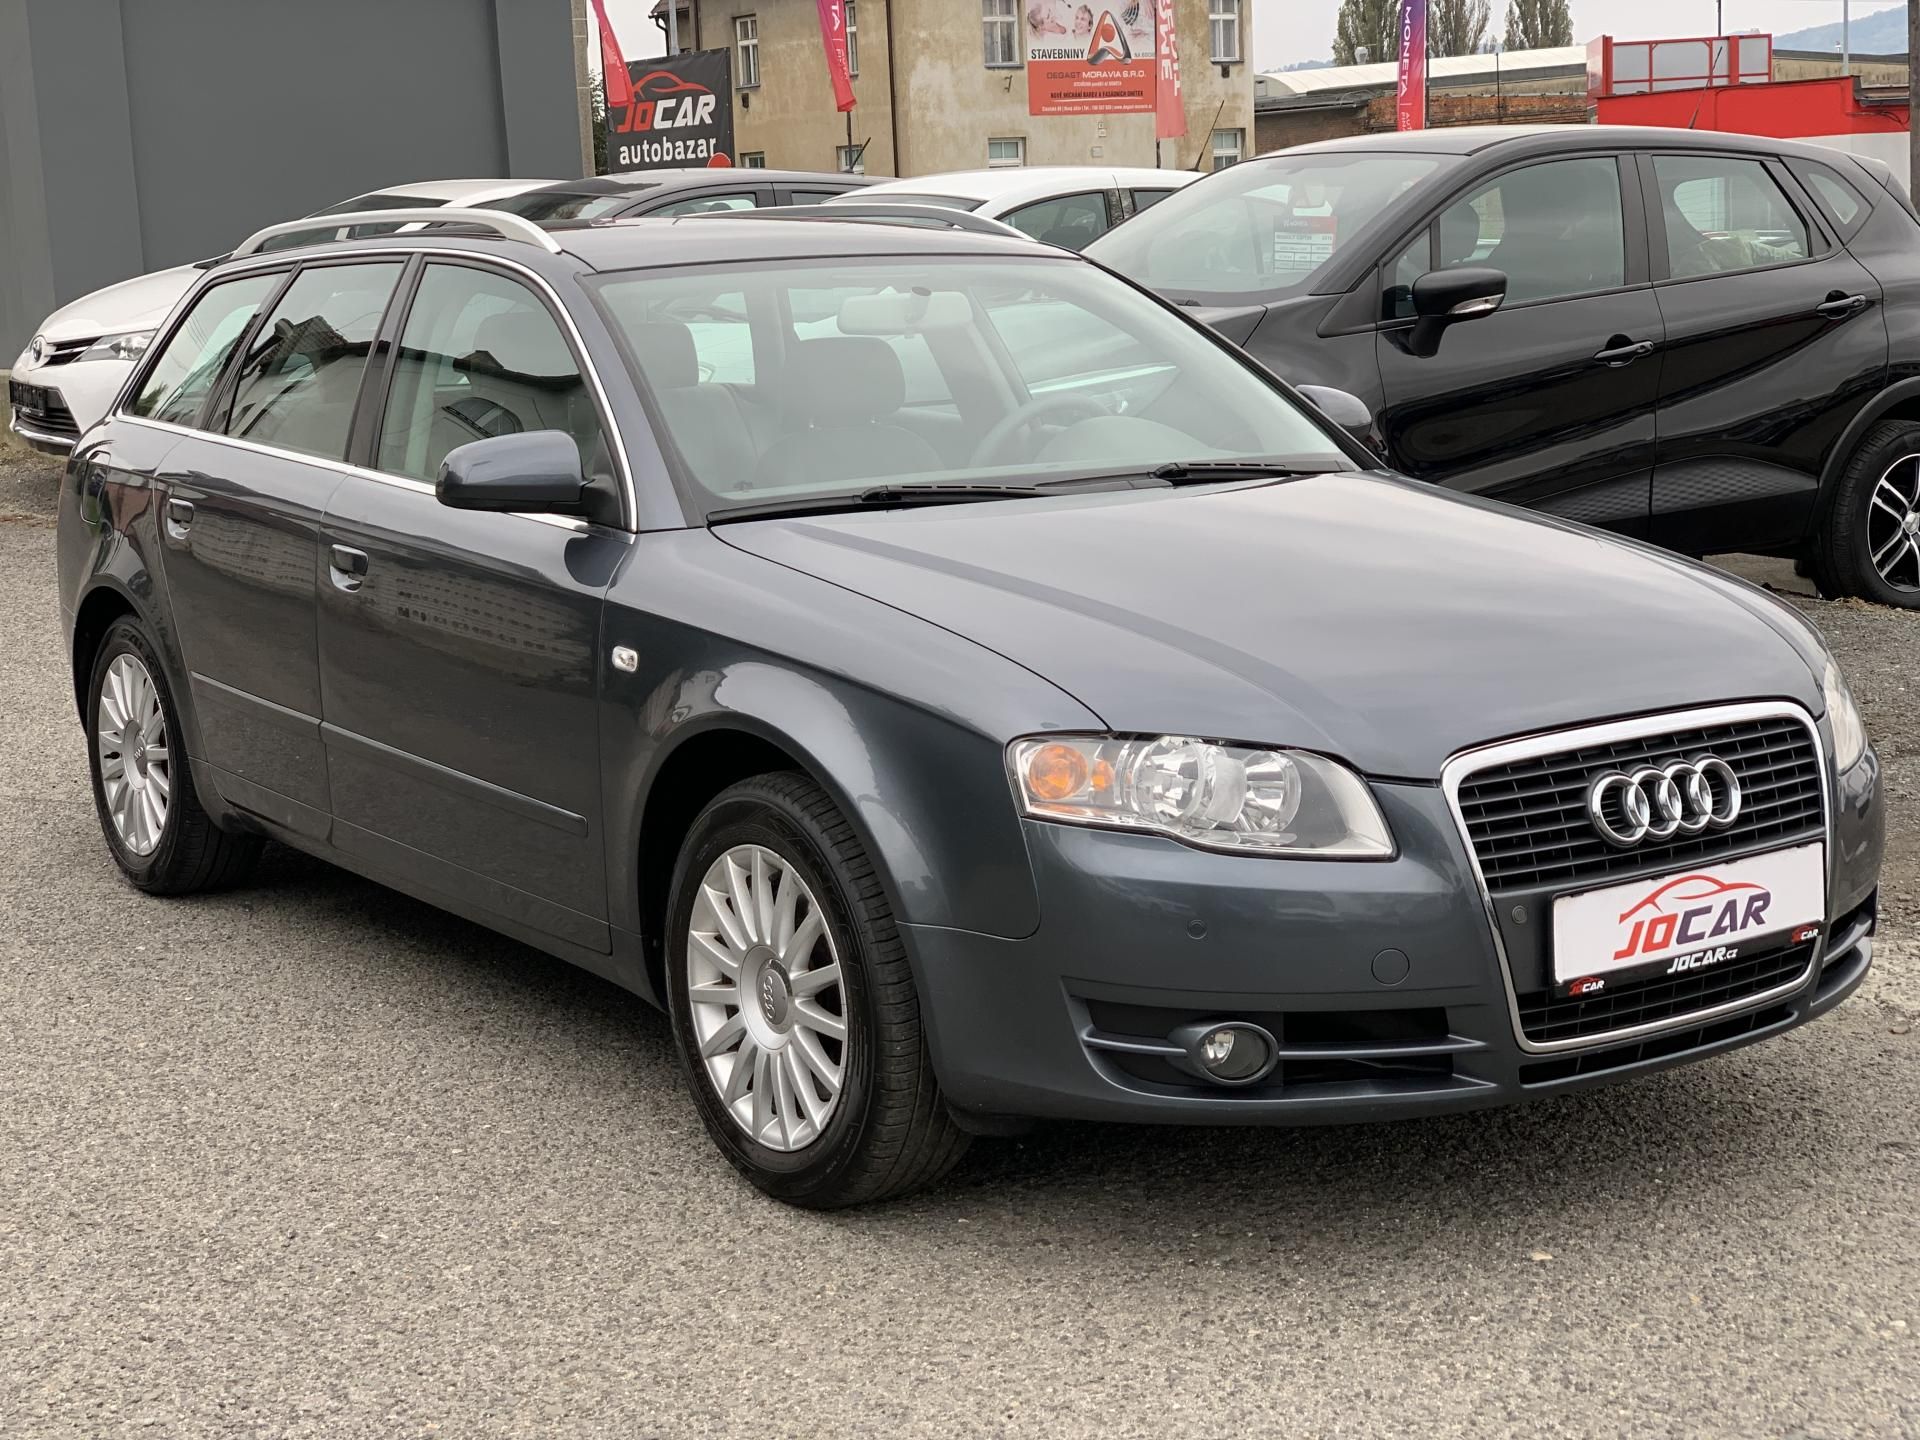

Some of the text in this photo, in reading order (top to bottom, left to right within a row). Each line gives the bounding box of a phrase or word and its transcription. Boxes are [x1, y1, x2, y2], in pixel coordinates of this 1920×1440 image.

[1031, 48, 1085, 60] STAVEBNINY
[1400, 6, 1413, 97] MONETA
[1082, 70, 1121, 79] MORAVIA
[617, 94, 716, 133] JOCAR
[619, 136, 717, 165] autobazar
[1613, 891, 1772, 960] JOCAR
[1666, 946, 1739, 974] JOCAR.cz
